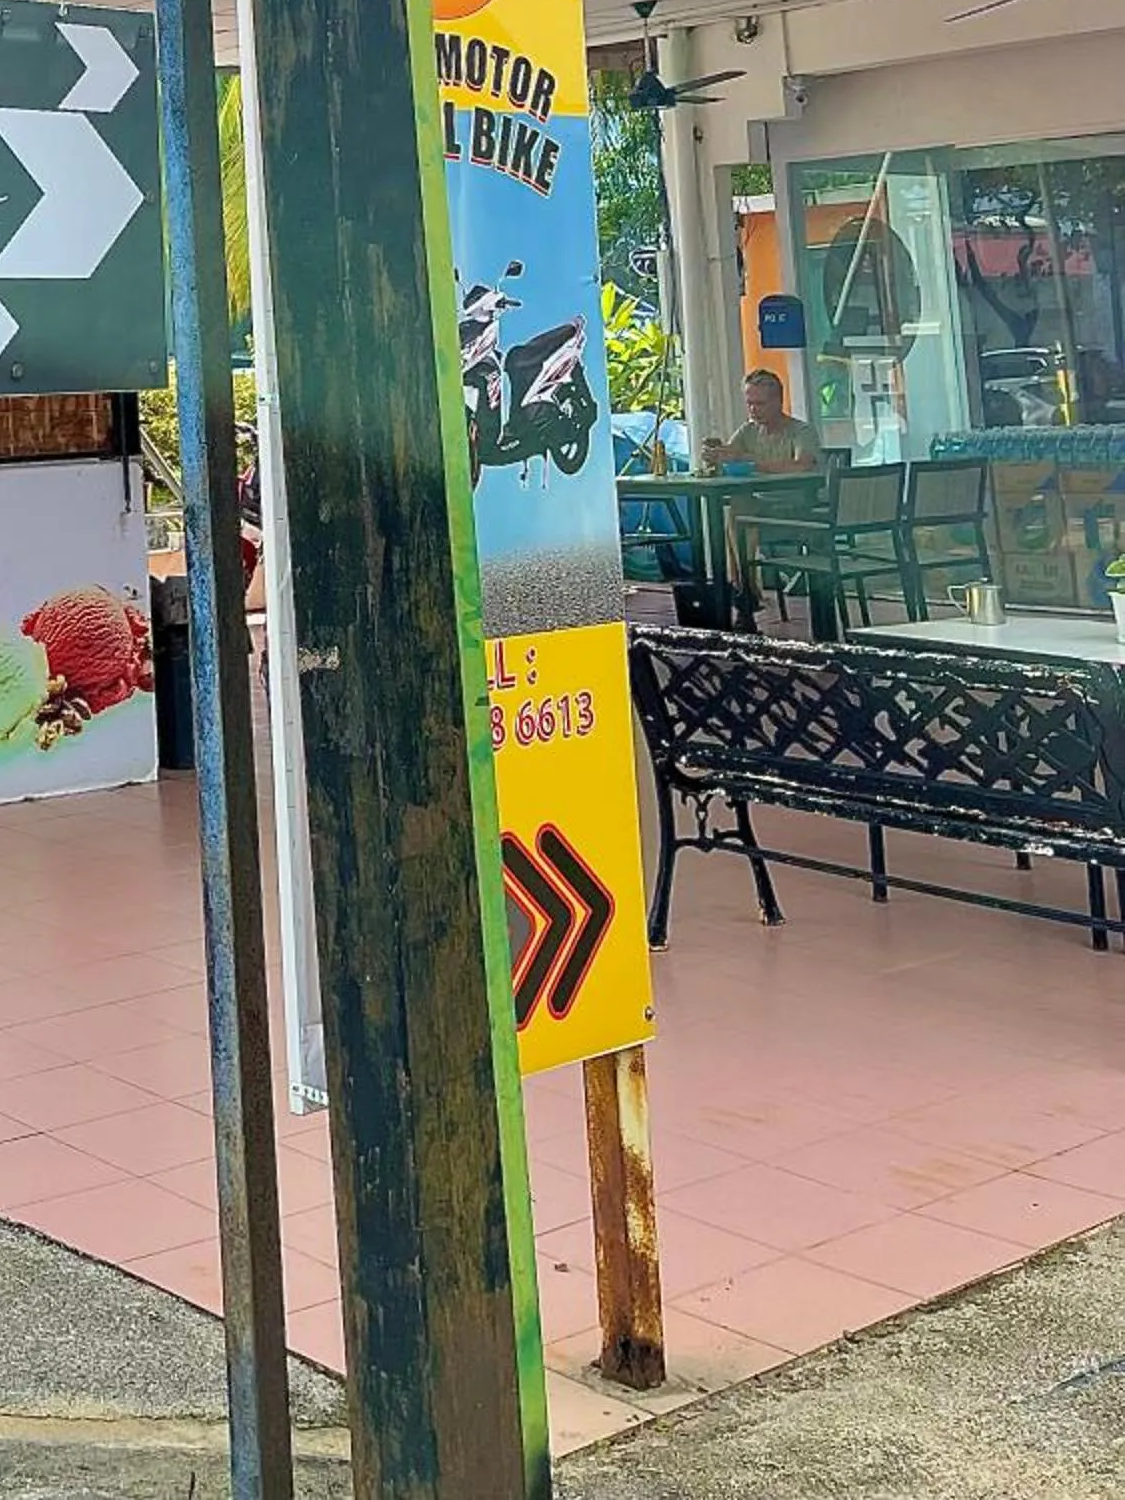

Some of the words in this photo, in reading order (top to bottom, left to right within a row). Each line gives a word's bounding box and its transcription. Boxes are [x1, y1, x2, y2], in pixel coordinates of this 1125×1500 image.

[434, 32, 557, 124] MOTOR
[470, 106, 562, 198] BIKE
[515, 690, 595, 746] 6613
